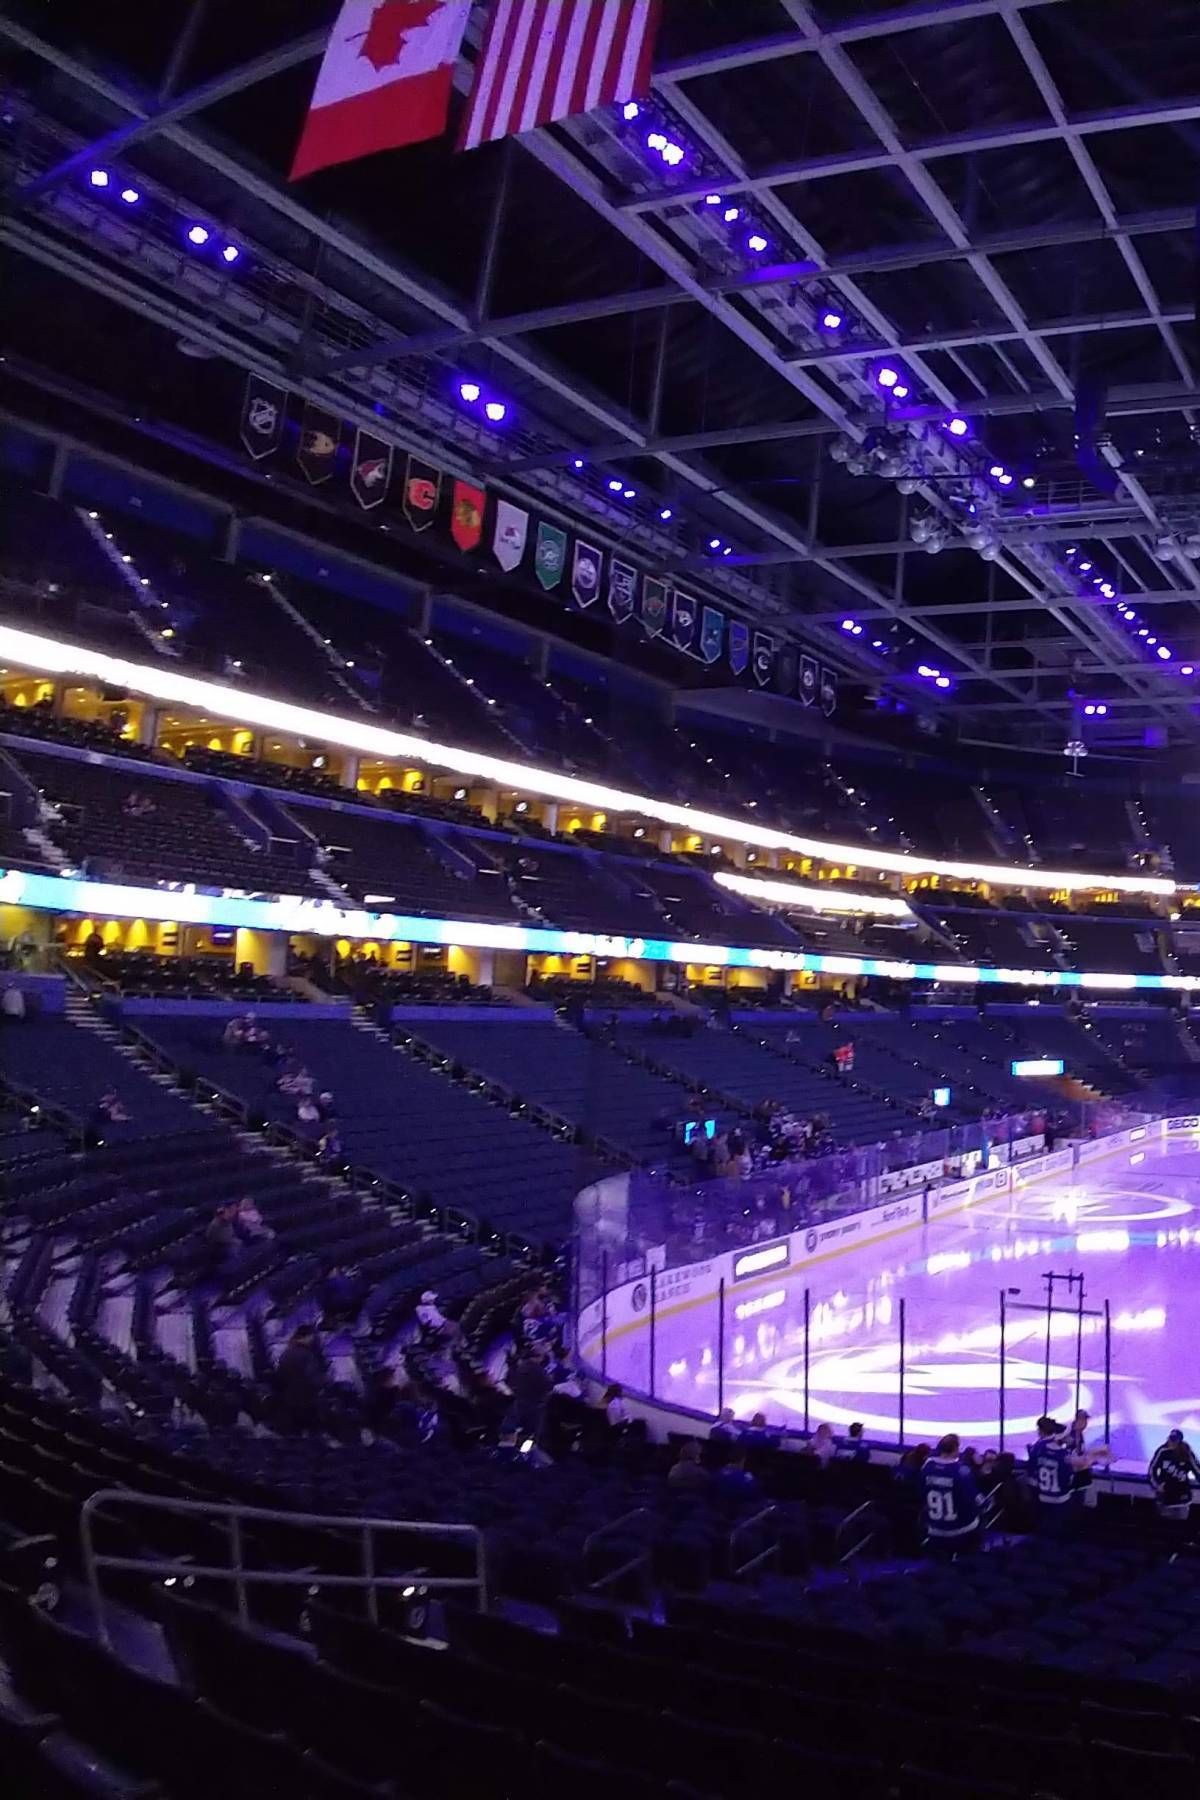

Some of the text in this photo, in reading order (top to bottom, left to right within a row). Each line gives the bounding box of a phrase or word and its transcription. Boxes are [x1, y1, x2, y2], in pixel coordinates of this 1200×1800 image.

[1167, 1117, 1199, 1130] GEICO
[1038, 1466, 1061, 1492] 91
[927, 1489, 958, 1521] 91
